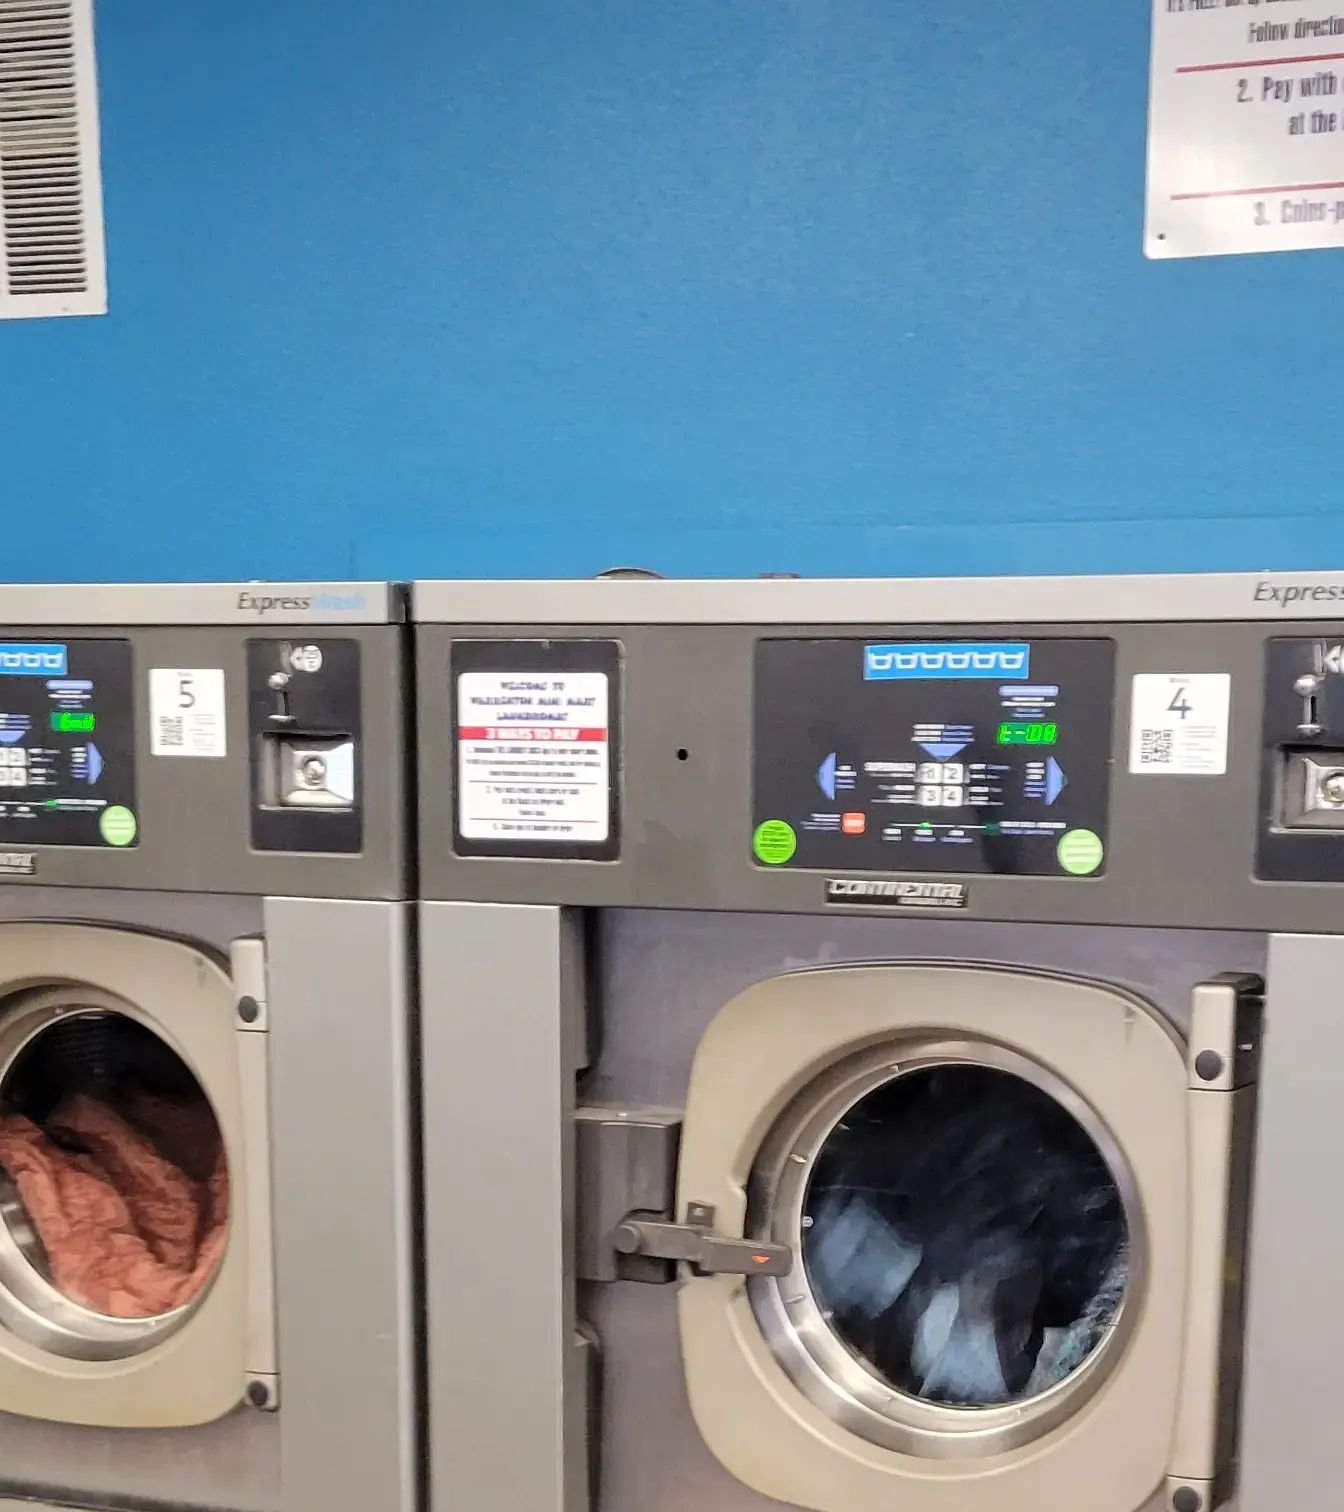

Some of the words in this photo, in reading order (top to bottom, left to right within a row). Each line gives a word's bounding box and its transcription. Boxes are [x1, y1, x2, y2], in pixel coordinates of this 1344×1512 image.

[1247, 21, 1289, 43] Follow
[1236, 78, 1254, 103] 2.
[1262, 75, 1294, 103] Pay
[1299, 71, 1337, 97] with
[1288, 111, 1305, 136] at
[1310, 108, 1338, 134] the
[1253, 201, 1271, 226] 3.
[177, 679, 197, 709] 5
[1166, 687, 1194, 720] 4
